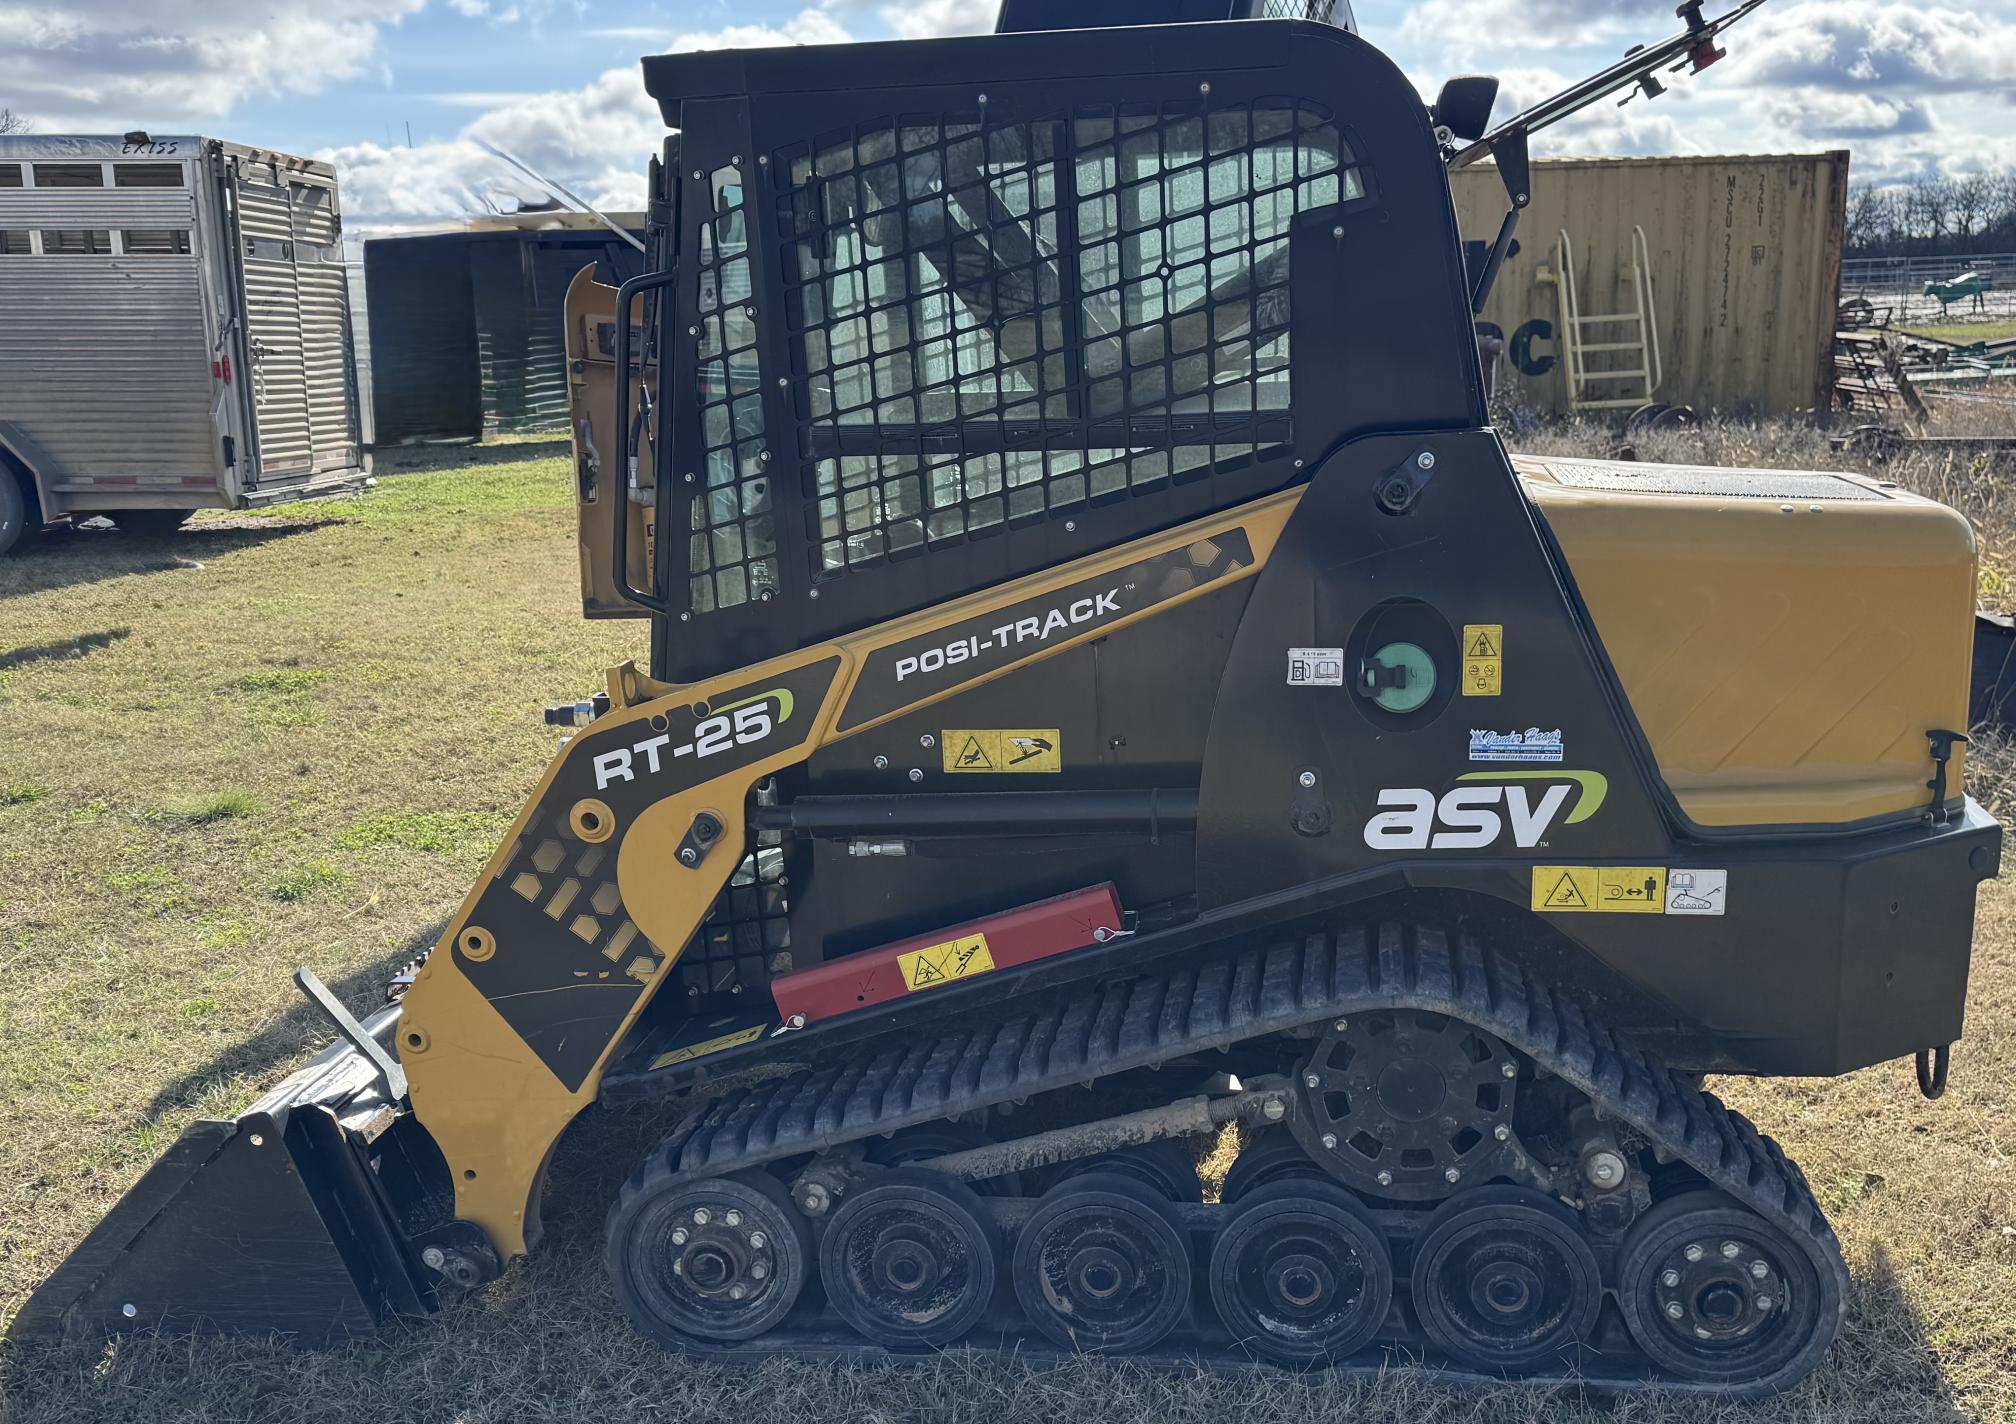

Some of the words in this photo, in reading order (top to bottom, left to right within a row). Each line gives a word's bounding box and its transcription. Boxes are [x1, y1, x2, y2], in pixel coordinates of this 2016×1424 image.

[1726, 175, 1736, 228] MSCU
[895, 588, 1122, 682] POSI-TRACK
[593, 702, 772, 790] RT-25
[1484, 731, 1522, 744] Vander
